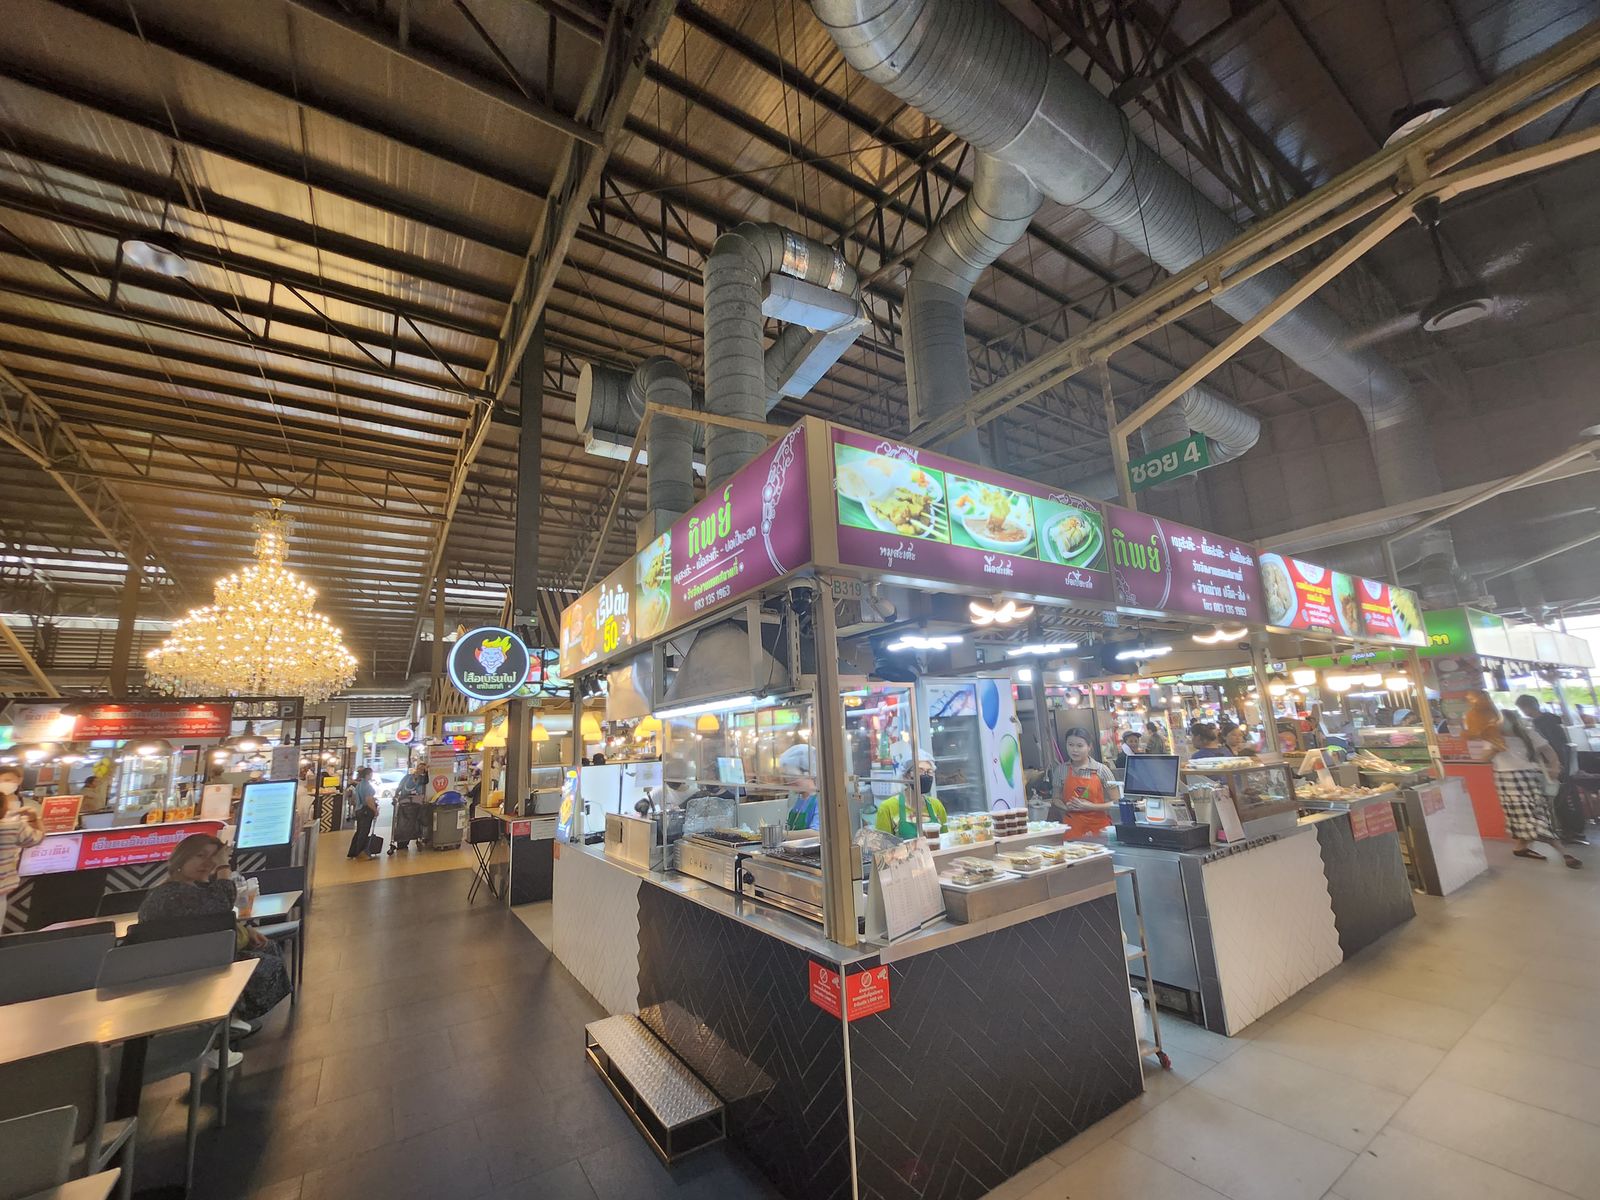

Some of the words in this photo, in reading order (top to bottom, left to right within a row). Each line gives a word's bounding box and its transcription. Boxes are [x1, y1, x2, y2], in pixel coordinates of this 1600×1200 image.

[1131, 451, 1179, 483] ซอย
[1184, 441, 1201, 463] 4
[688, 483, 733, 559] ทิพย์
[1111, 528, 1161, 573] ทิพย์
[706, 592, 715, 607] 135
[716, 585, 731, 602] 1963
[833, 579, 862, 597] B319
